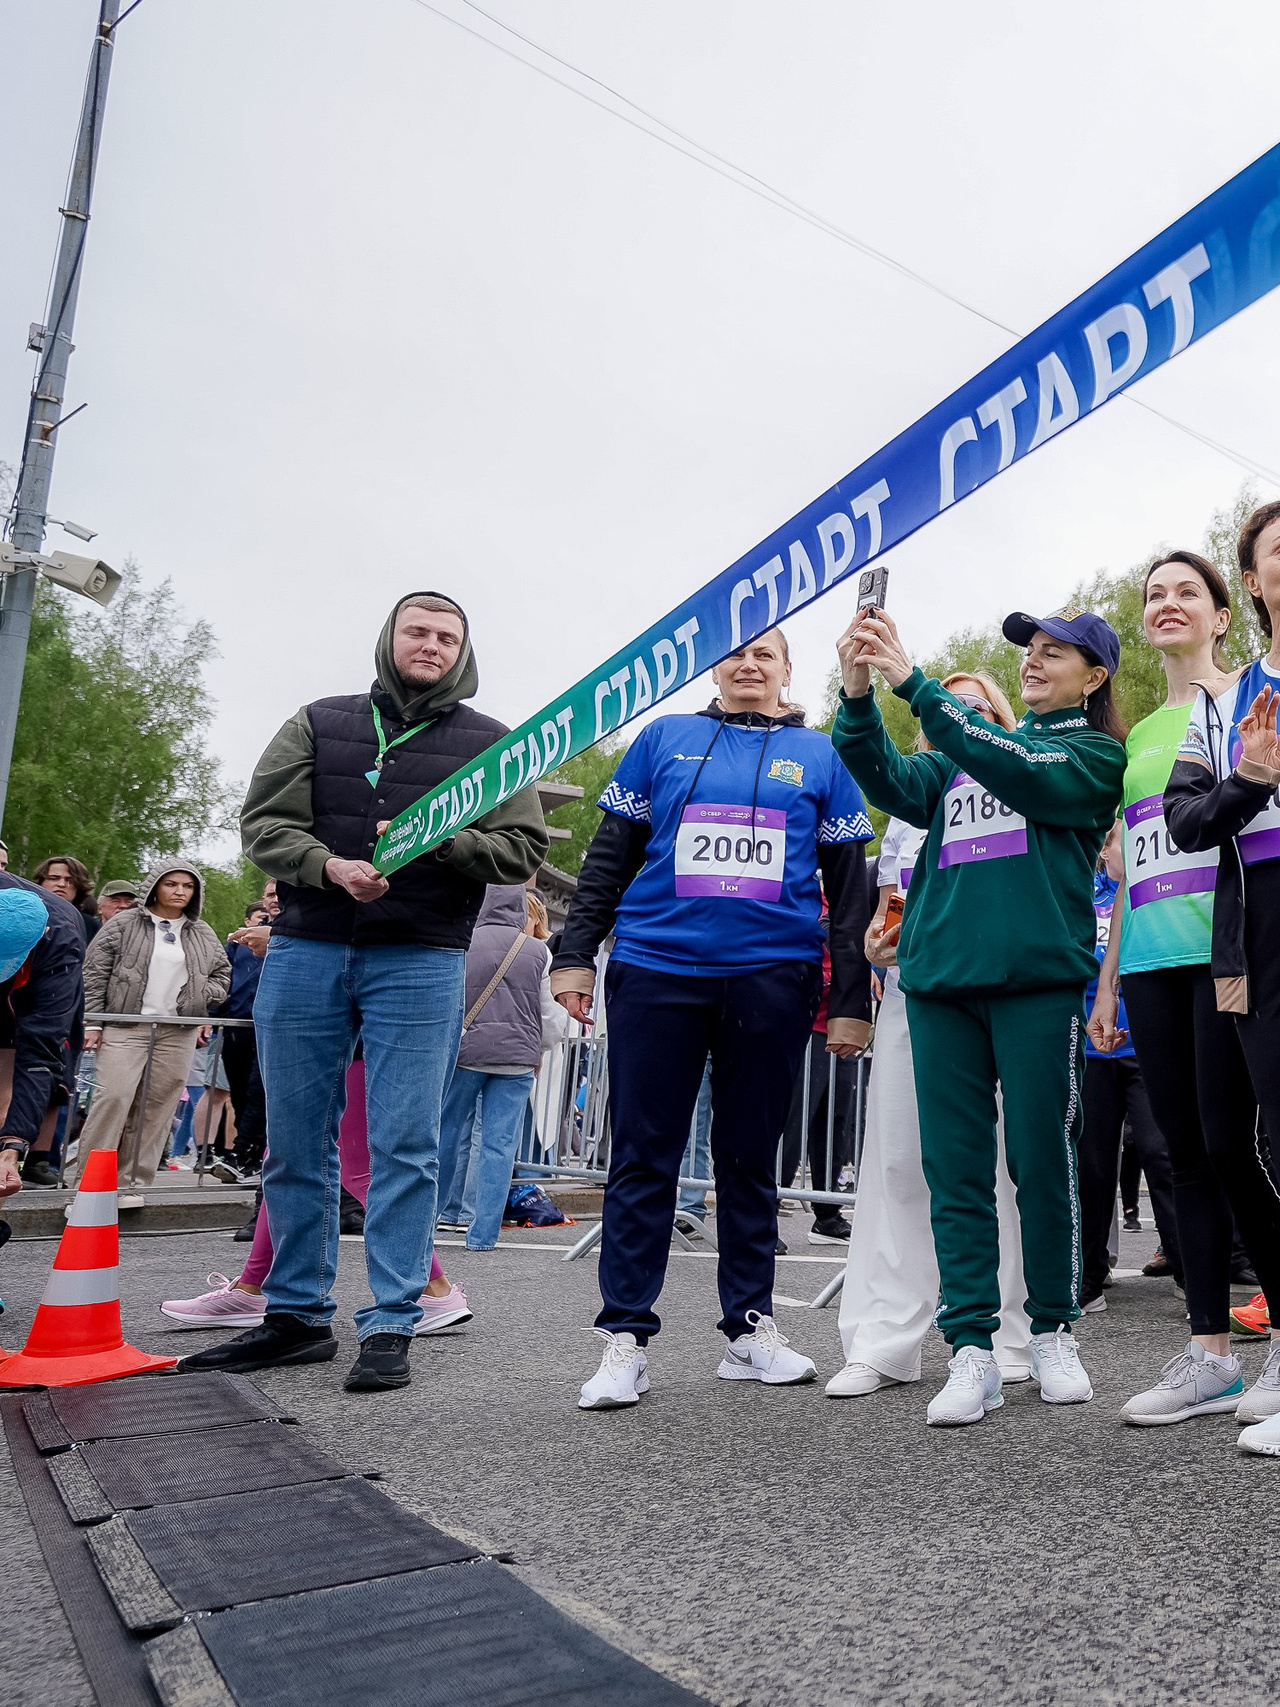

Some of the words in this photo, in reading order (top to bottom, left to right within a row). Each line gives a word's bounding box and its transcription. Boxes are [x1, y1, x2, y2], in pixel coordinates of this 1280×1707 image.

[939, 242, 1211, 512] СТАРТ
[729, 478, 891, 651] СТАРТ
[593, 616, 700, 742] СТАРТ
[422, 767, 486, 845] СТАРТ
[495, 705, 574, 803] СТАРТ
[692, 835, 773, 866] 2000
